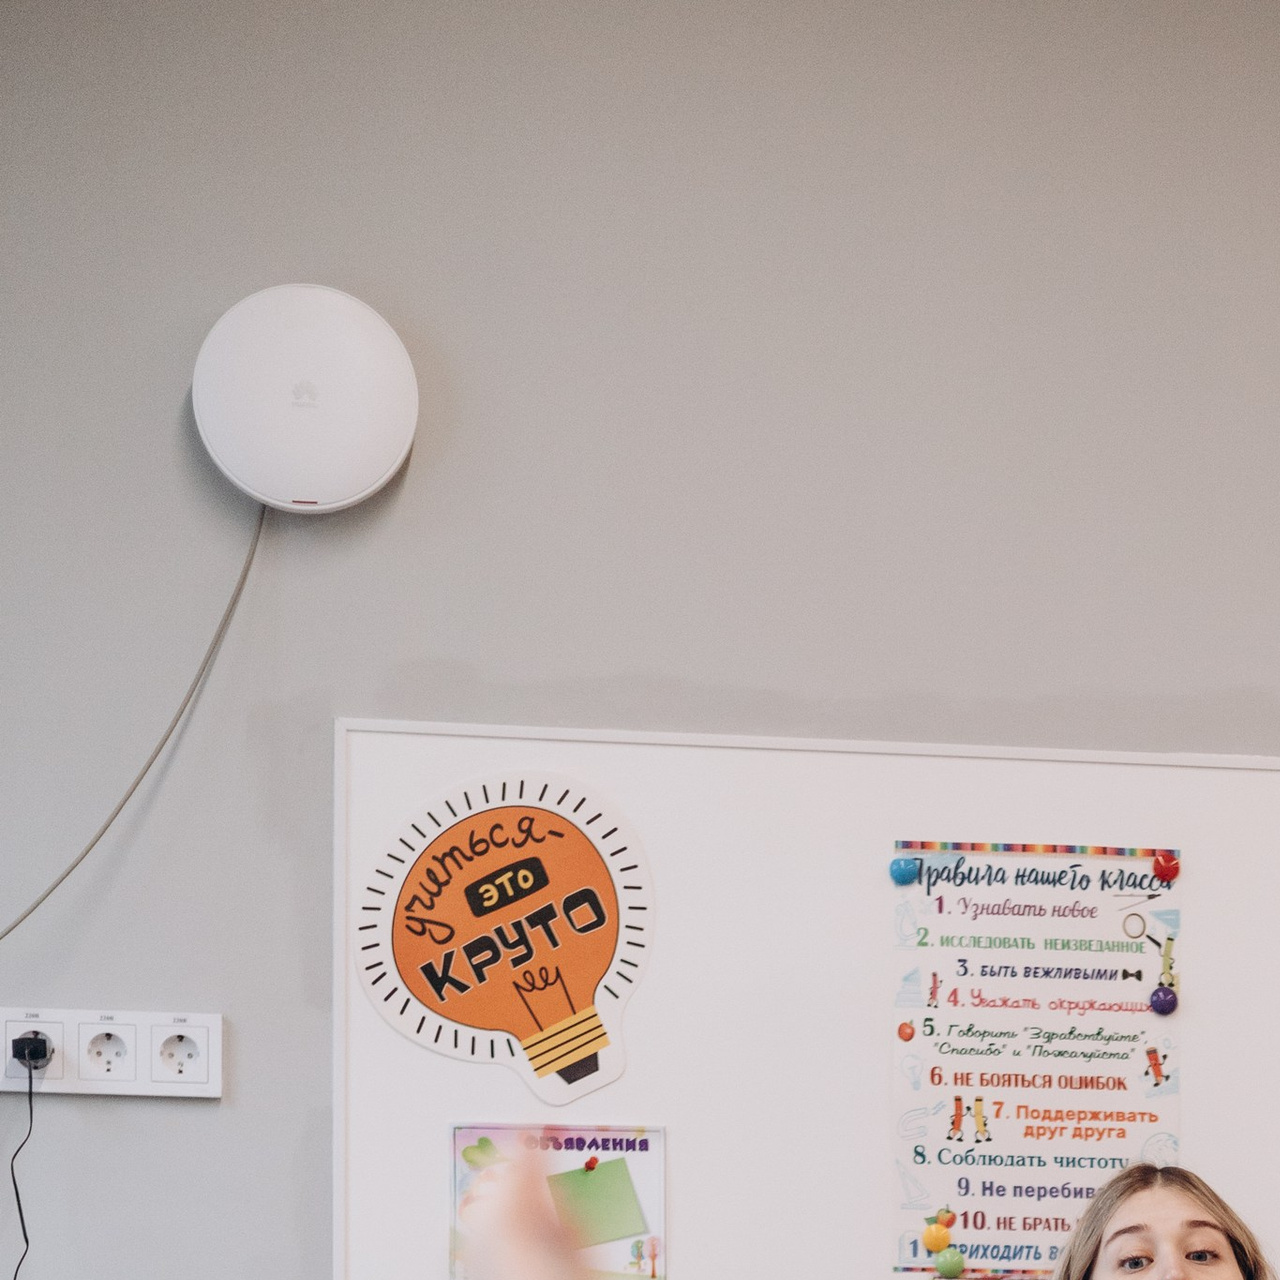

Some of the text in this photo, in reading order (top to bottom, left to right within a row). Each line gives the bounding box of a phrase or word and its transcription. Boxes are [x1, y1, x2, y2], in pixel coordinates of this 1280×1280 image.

[477, 868, 536, 908] ЭТО
[1014, 863, 1091, 891] нашего
[934, 895, 1099, 921] 1. Узнавать новое
[417, 886, 608, 1003] КРУТО
[916, 926, 1147, 955] 2. ИССЛЕДОВАТЬ НЕИЗВЕДАННОЕ
[956, 958, 1119, 981] 3. БЫТЬ ВЕЖЛИВЫМИ
[946, 987, 966, 1008] 4.
[970, 988, 1041, 1010] Уважать
[921, 1017, 941, 1037] 5.
[946, 1023, 1019, 1042] Говорить
[1012, 1048, 1022, 1057] и
[930, 1065, 1128, 1091] 6. НЕ БОЯТЬСЯ ОШИБОК
[992, 1101, 1160, 1124] 7. Поддерживать
[1023, 1125, 1128, 1141] друг друга
[912, 1144, 932, 1166] 8.
[936, 1147, 1048, 1168] Соблюдать
[957, 1176, 1096, 1202] 9. Не перебив
[959, 1210, 1072, 1233] 10. НЕ БРАТЬ
